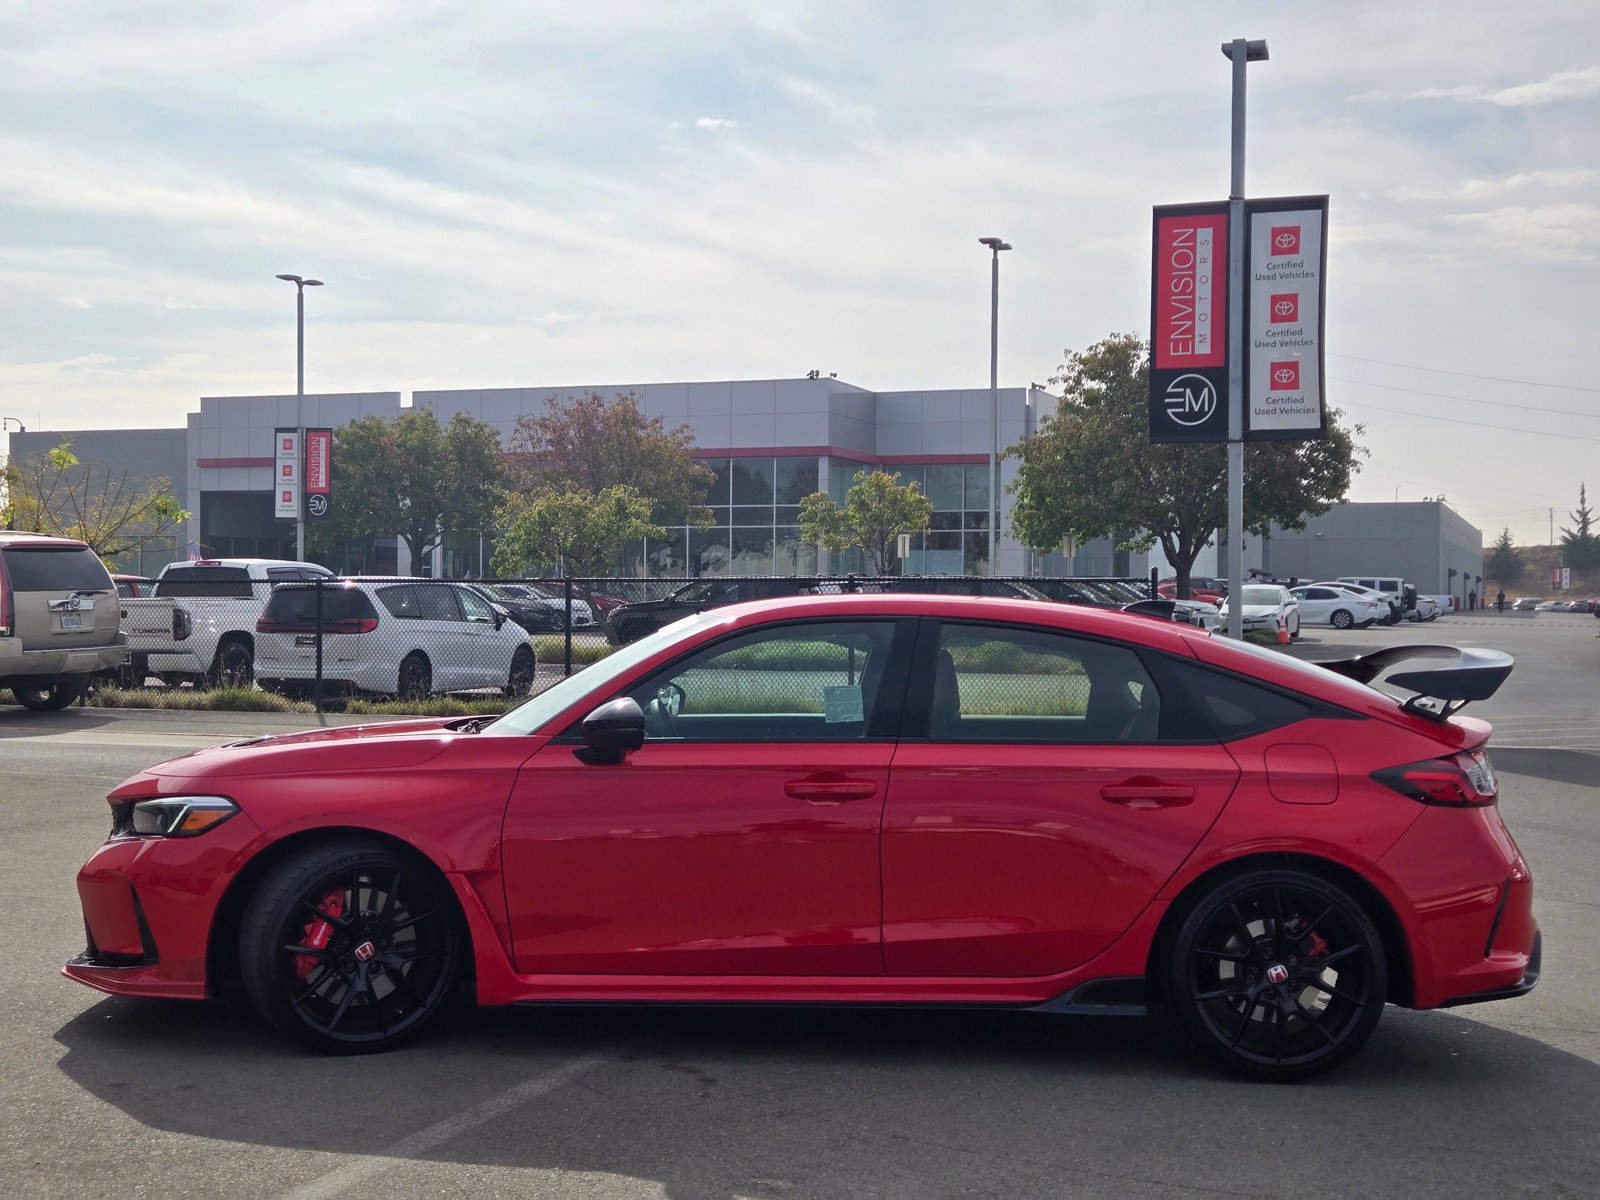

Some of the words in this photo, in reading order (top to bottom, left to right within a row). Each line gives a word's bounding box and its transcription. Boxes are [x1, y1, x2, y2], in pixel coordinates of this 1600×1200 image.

[1266, 260, 1304, 270] Certified
[1255, 272, 1277, 281] Used
[1279, 270, 1315, 280] Vehicles
[1170, 227, 1195, 356] ENVISION
[1198, 239, 1209, 344] MOTORS
[1265, 328, 1303, 338] Certified
[1254, 340, 1277, 348] Used
[1279, 338, 1314, 348] Vehicles
[1265, 395, 1305, 405] Certified
[1254, 406, 1277, 415] Used
[1279, 406, 1316, 415] Vehicles
[310, 436, 320, 488] ENVISION
